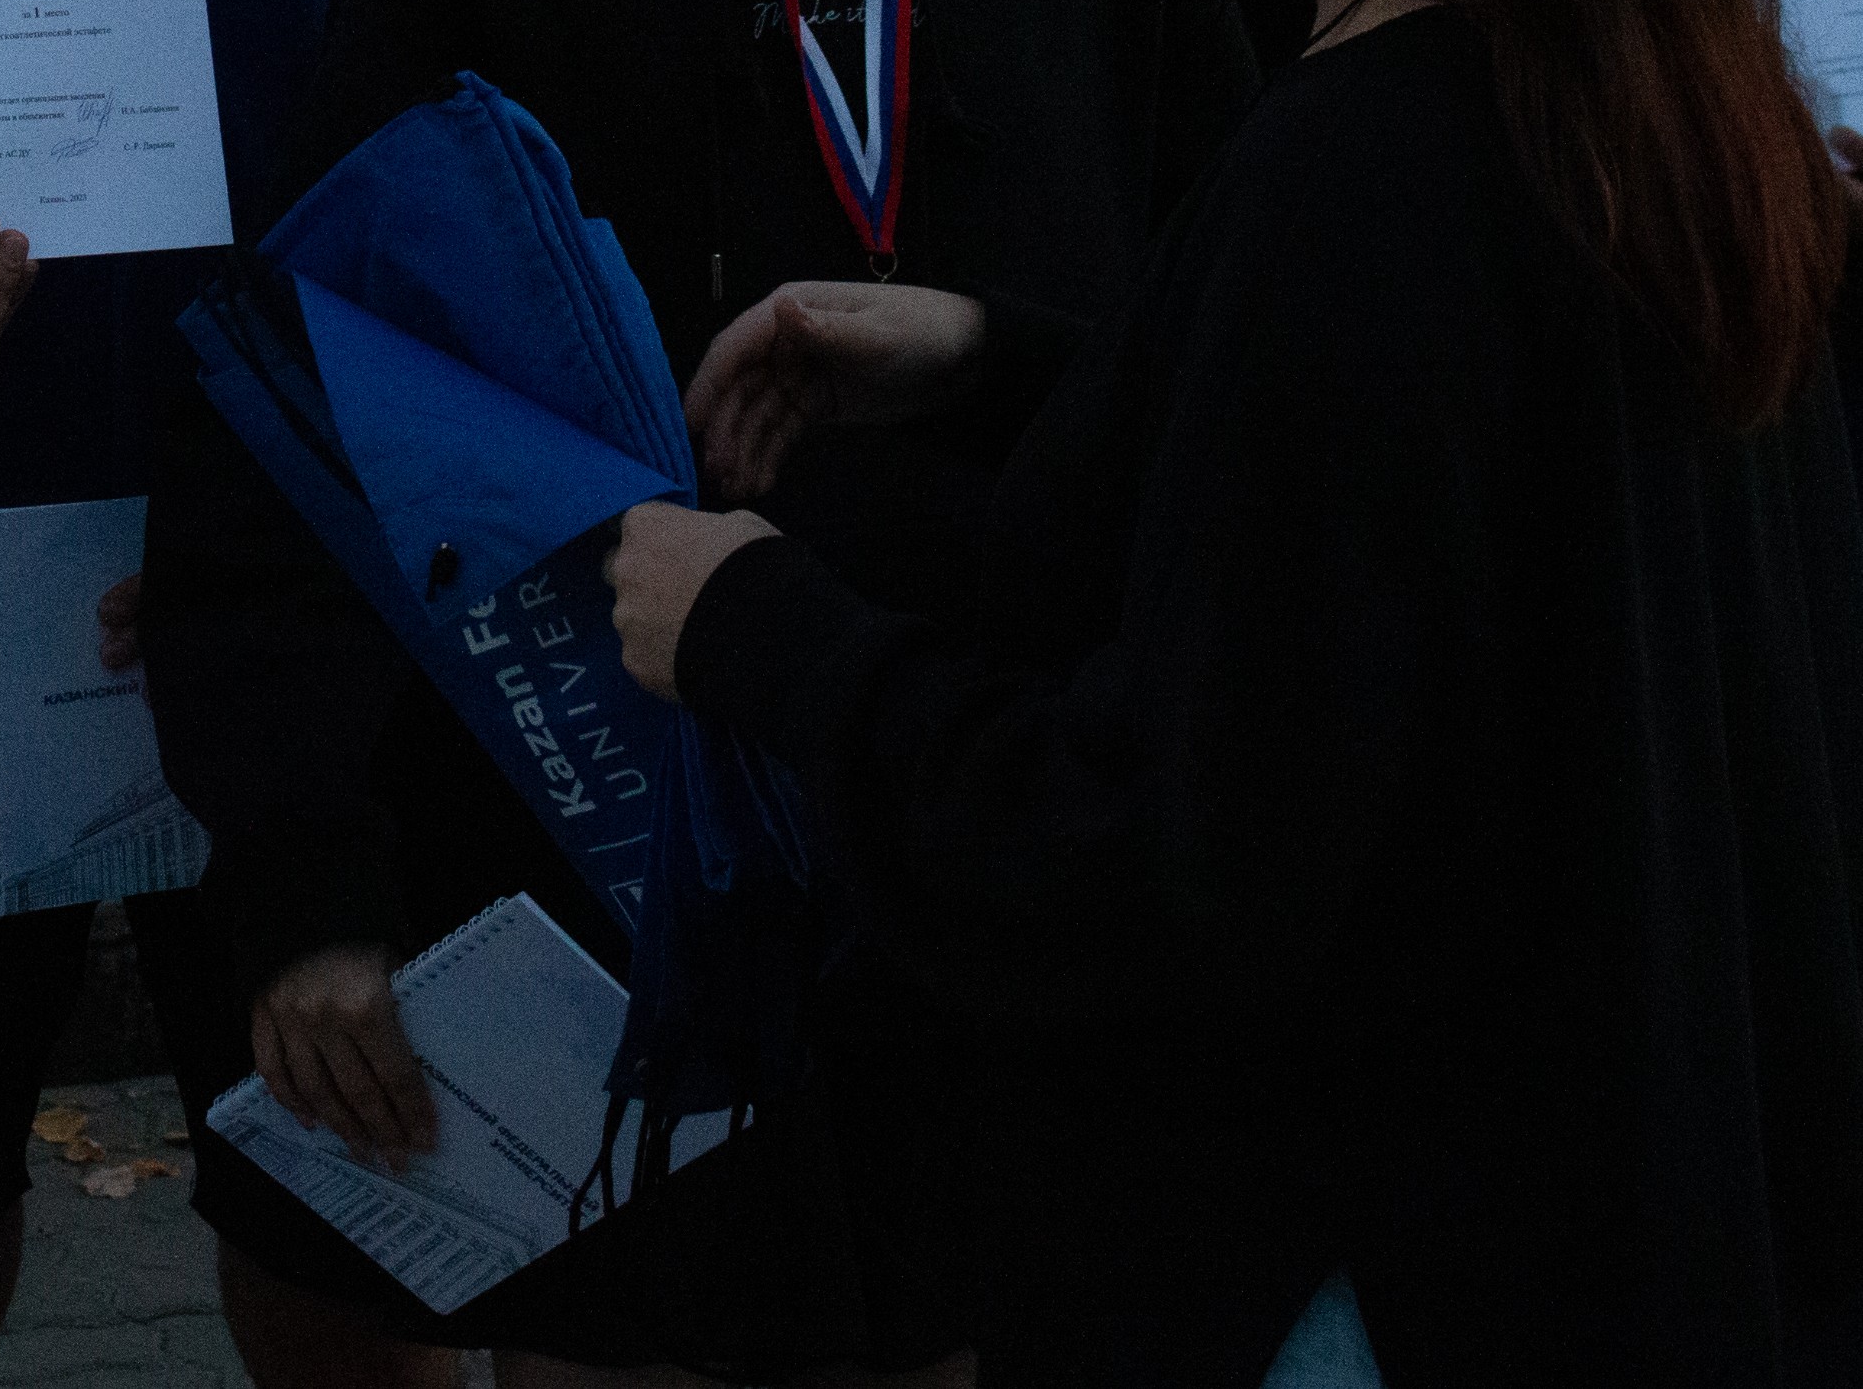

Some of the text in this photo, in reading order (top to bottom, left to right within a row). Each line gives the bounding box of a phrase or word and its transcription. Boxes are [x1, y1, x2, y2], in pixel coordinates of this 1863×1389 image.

[44, 9, 70, 19] место
[44, 677, 139, 706] КАЗАНСКИЙ
[518, 572, 648, 800] UNIVER
[495, 664, 596, 819] Kazan
